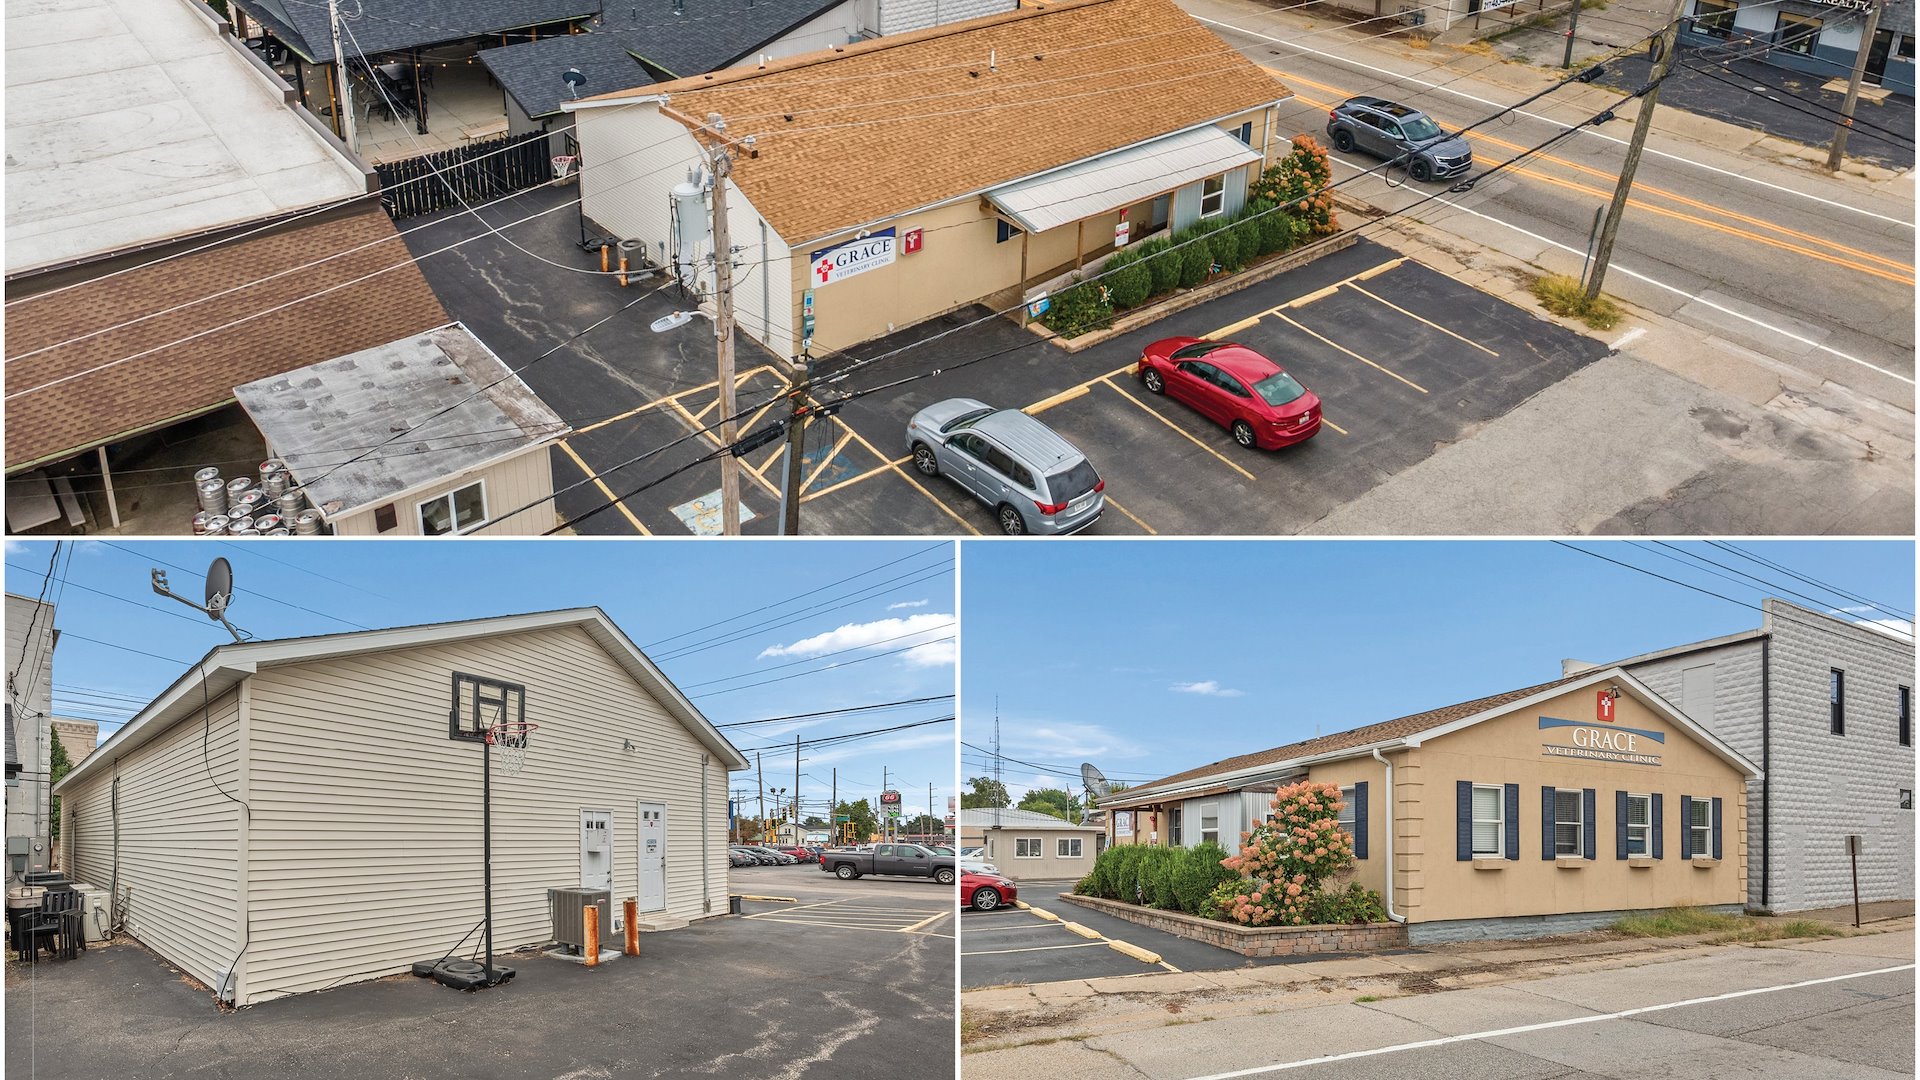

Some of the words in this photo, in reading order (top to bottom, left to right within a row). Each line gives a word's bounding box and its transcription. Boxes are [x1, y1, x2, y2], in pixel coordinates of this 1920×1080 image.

[836, 239, 892, 267] GRACE
[836, 263, 870, 278] VETERINARY
[871, 257, 890, 267] CLINIC
[1572, 727, 1637, 752] GRACE
[1546, 746, 1619, 761] VETERINARY
[1622, 754, 1660, 764] CLINIC
